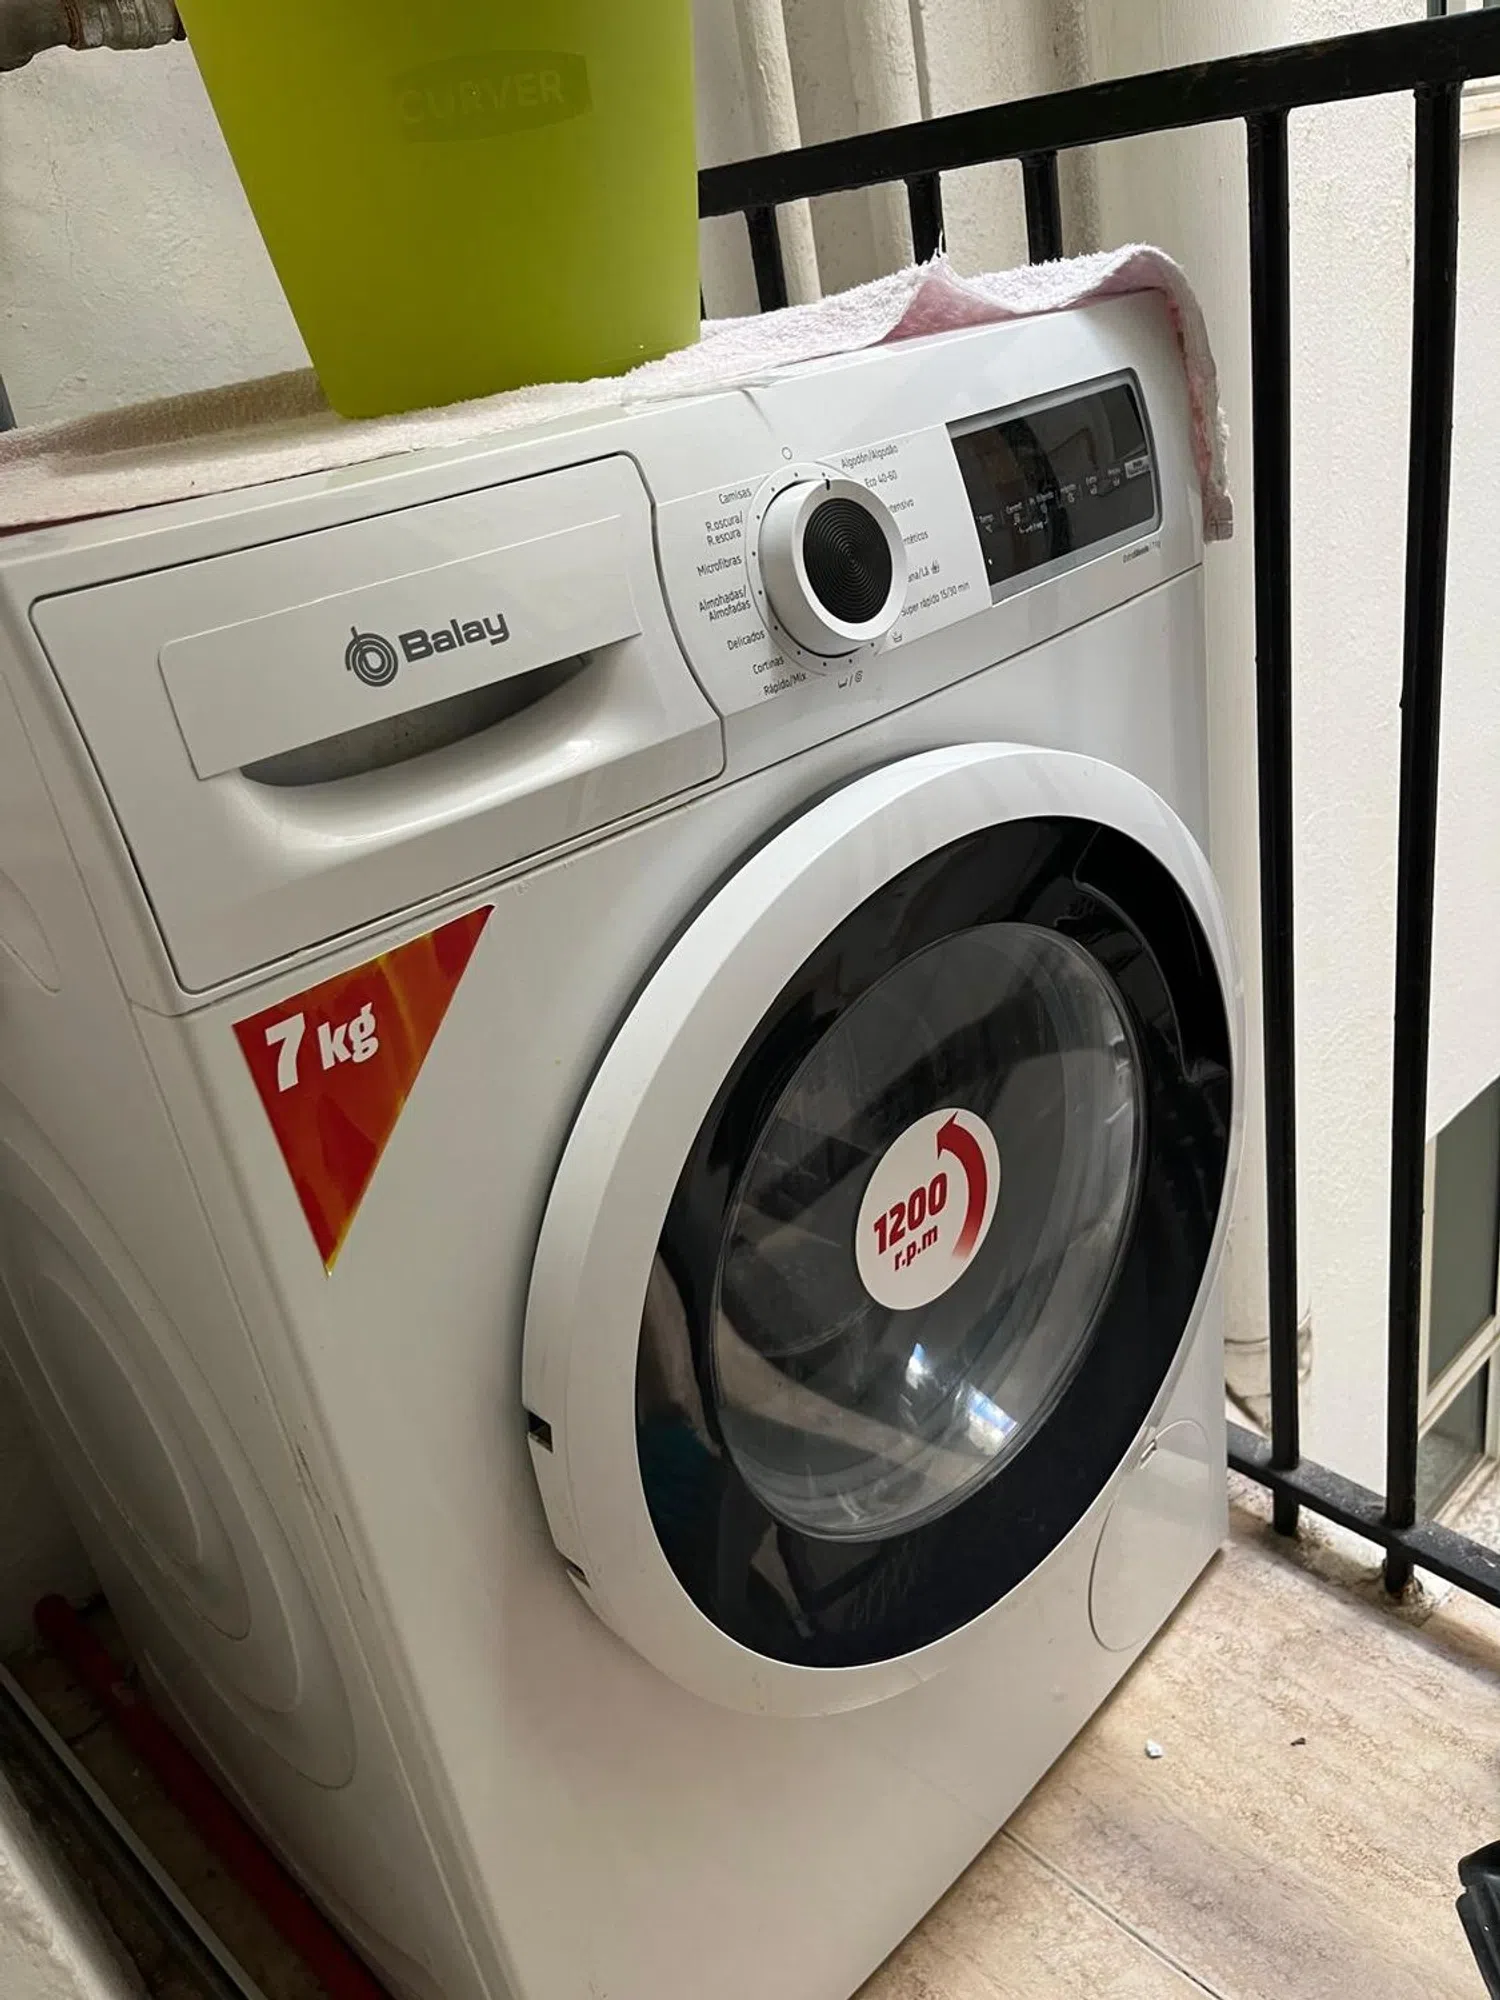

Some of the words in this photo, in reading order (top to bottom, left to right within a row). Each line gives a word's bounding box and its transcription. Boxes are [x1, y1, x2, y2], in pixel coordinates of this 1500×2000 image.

[399, 69, 565, 124] CURVER
[864, 478, 878, 488] Eco
[878, 469, 898, 484] 40-60
[718, 487, 752, 505] Camisas
[696, 555, 742, 577] Microfibras
[699, 584, 747, 612] Almohadas/
[709, 600, 751, 621] Almofadas
[398, 613, 510, 663] Balay
[726, 630, 766, 651] Delicados
[752, 656, 785, 675] Cortinas
[763, 672, 807, 696] Rápido/Mix
[265, 1011, 306, 1093] 7
[317, 1001, 379, 1071] kg
[873, 1172, 948, 1256] 1200
[894, 1225, 938, 1271] r.p.m
